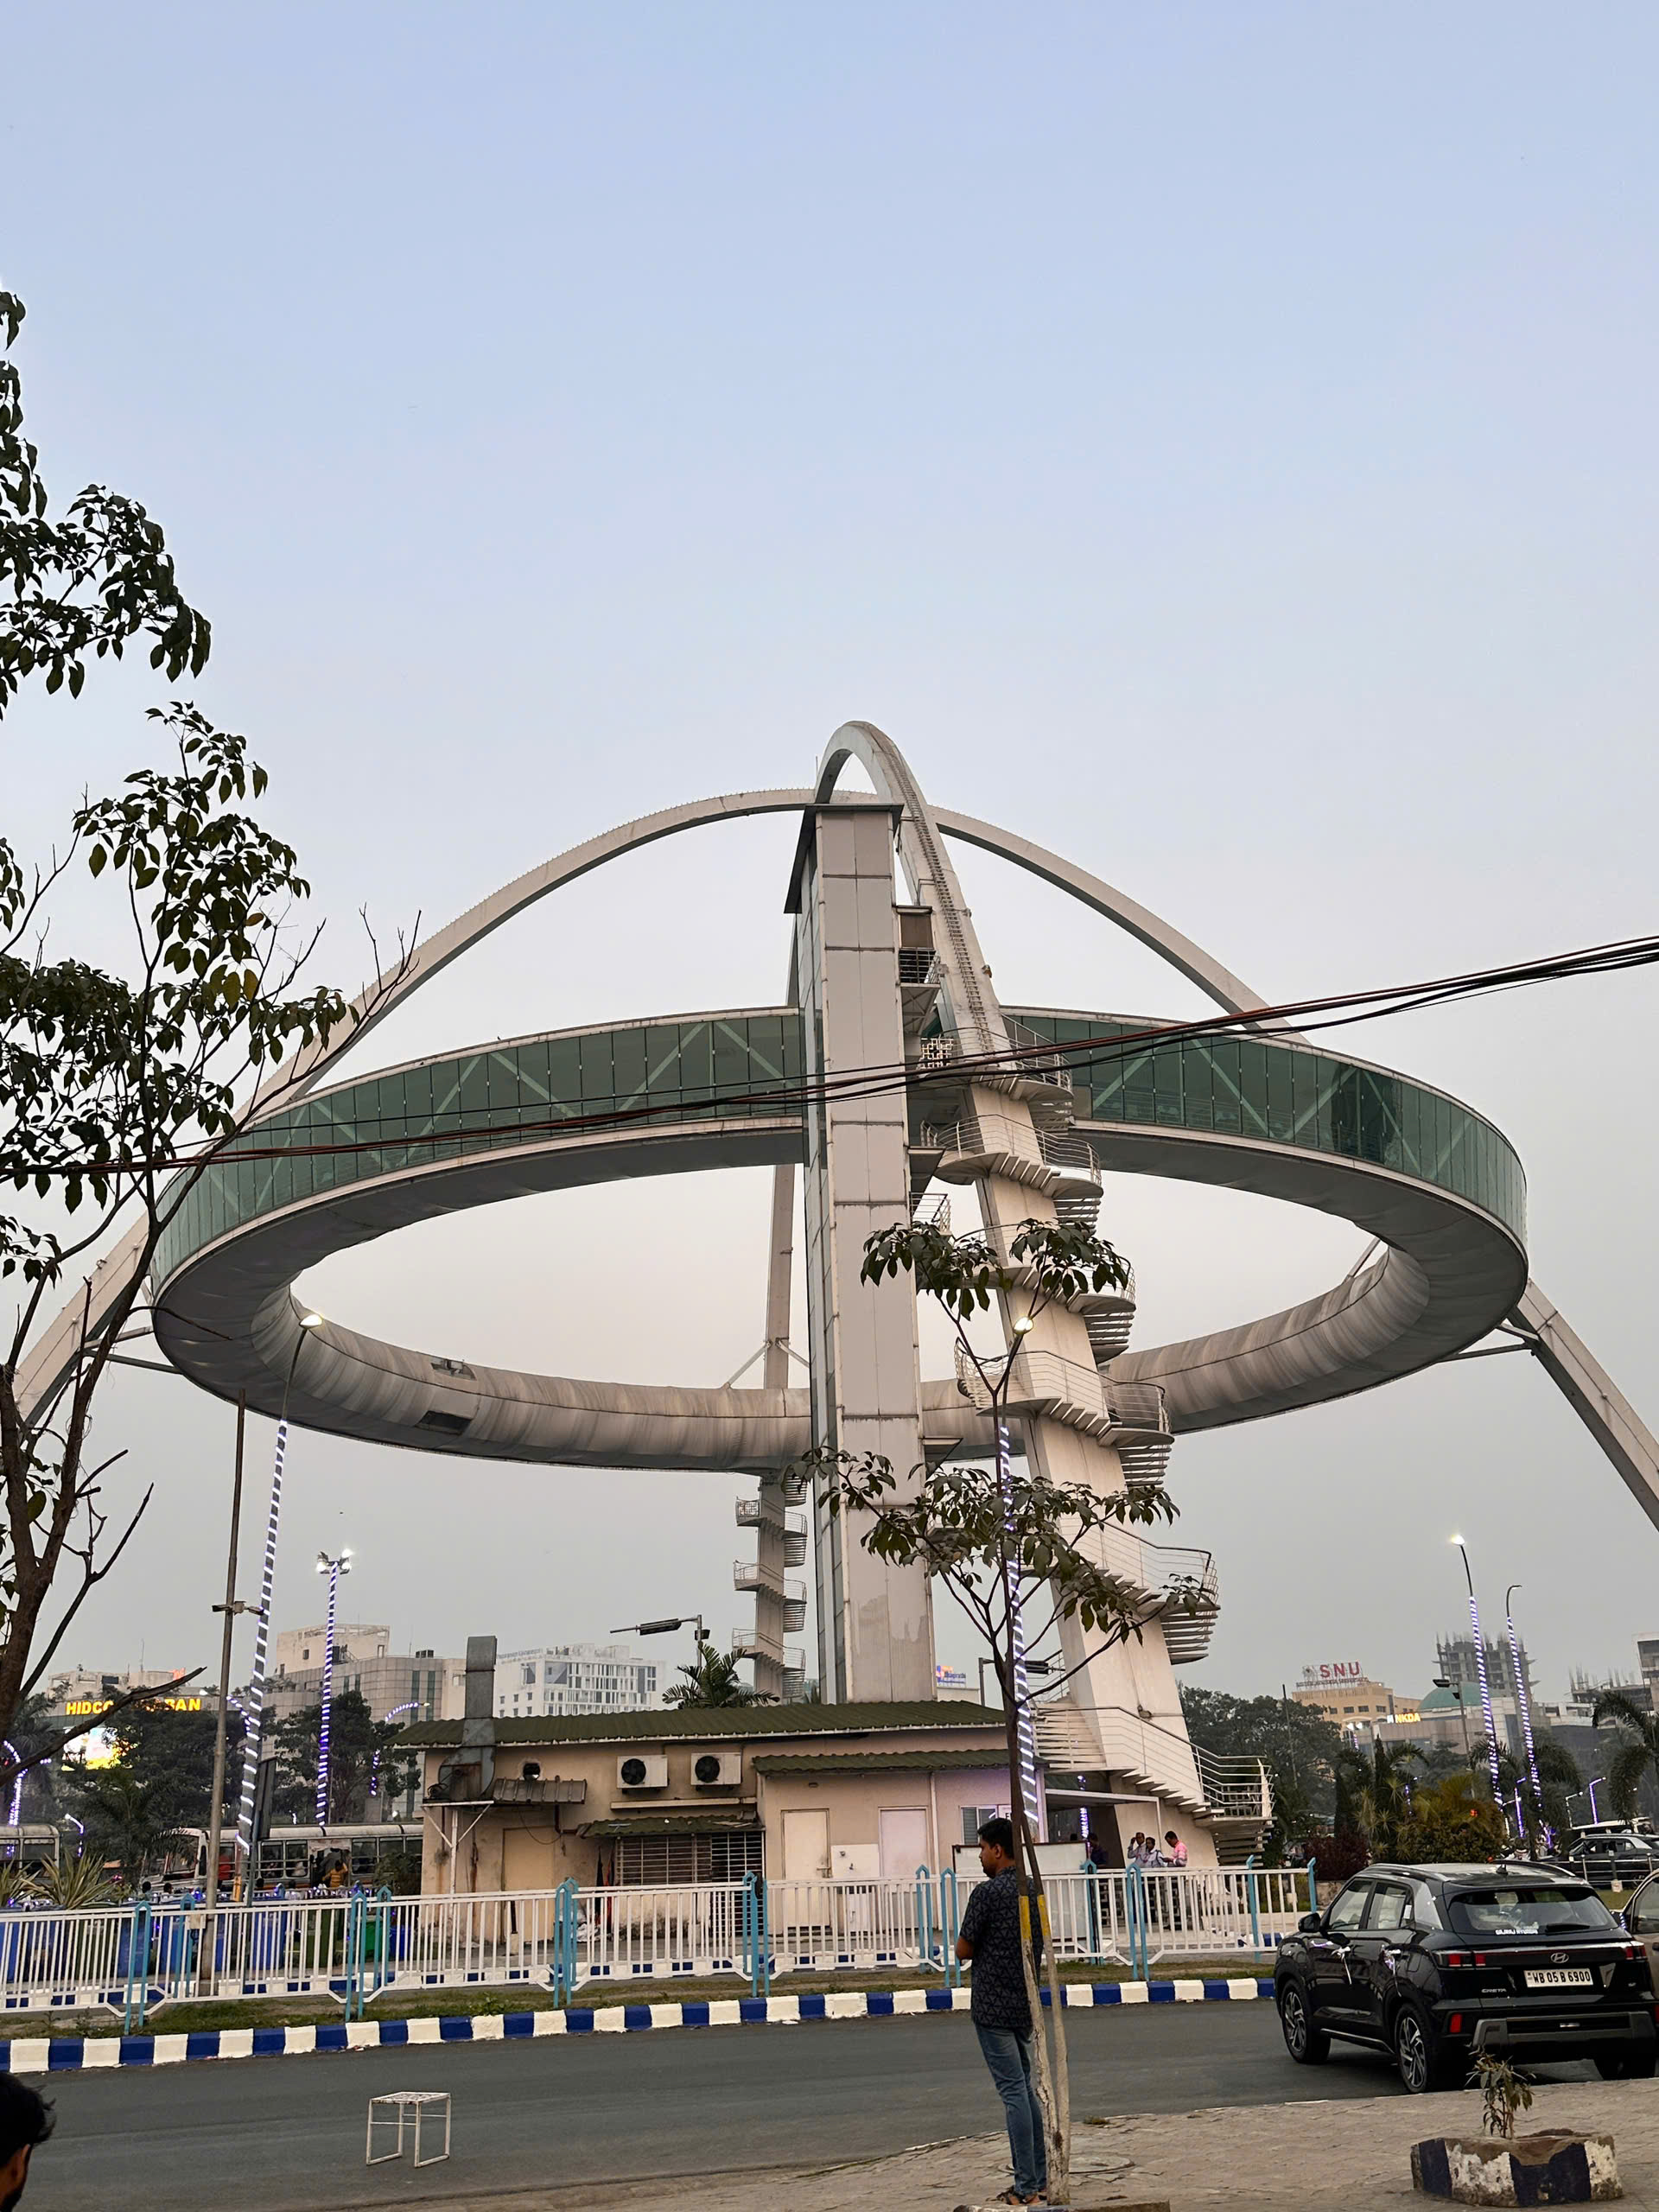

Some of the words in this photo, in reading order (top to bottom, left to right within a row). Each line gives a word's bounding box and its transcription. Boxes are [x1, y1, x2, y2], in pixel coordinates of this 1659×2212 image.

[1319, 1661, 1360, 1678] SNU
[1395, 1713, 1421, 1724] NKDA
[1533, 1972, 1545, 1983] WB
[1546, 1971, 1559, 1983] 05
[1560, 1971, 1567, 1983] B
[1567, 1971, 1591, 1982] 6900
